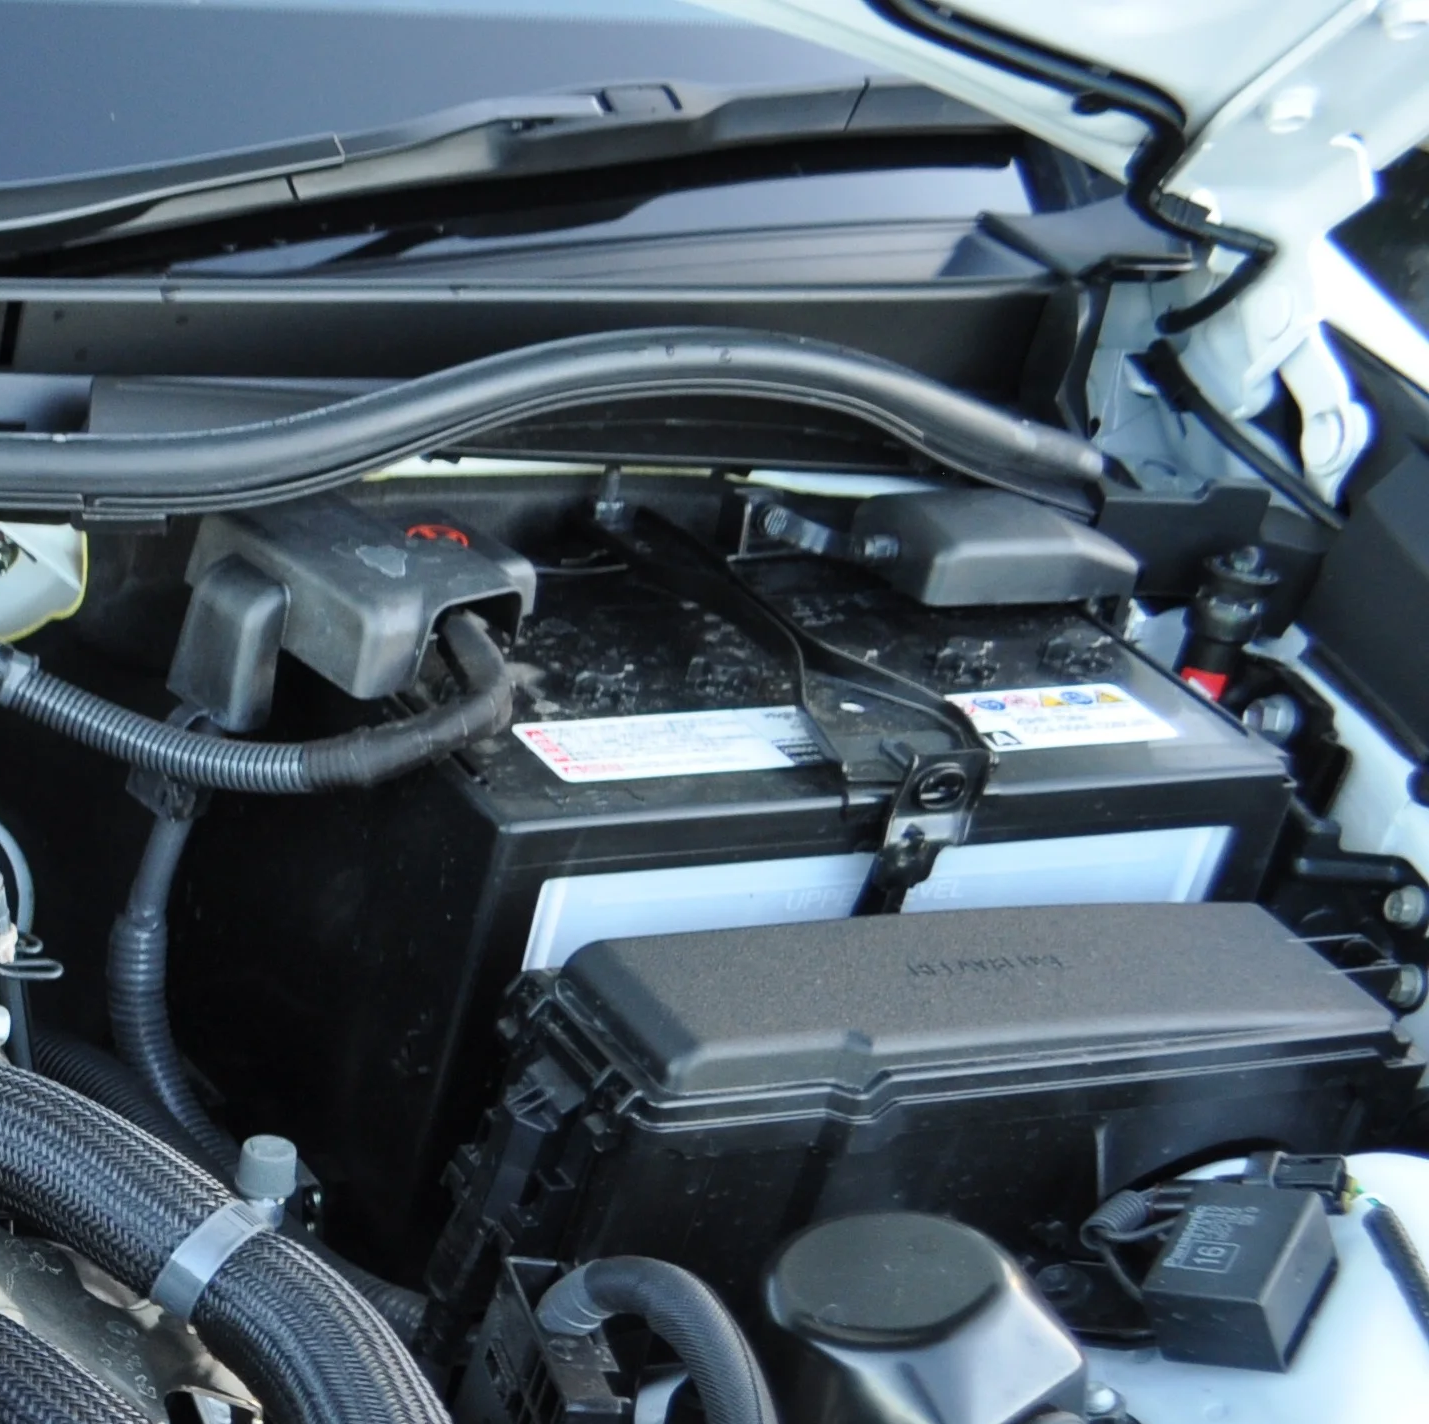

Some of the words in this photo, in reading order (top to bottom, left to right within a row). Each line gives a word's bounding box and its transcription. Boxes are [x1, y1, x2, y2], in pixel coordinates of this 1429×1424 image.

[785, 885, 856, 911] UPPE
[908, 877, 964, 903] VEL
[1191, 1246, 1226, 1265] 16
